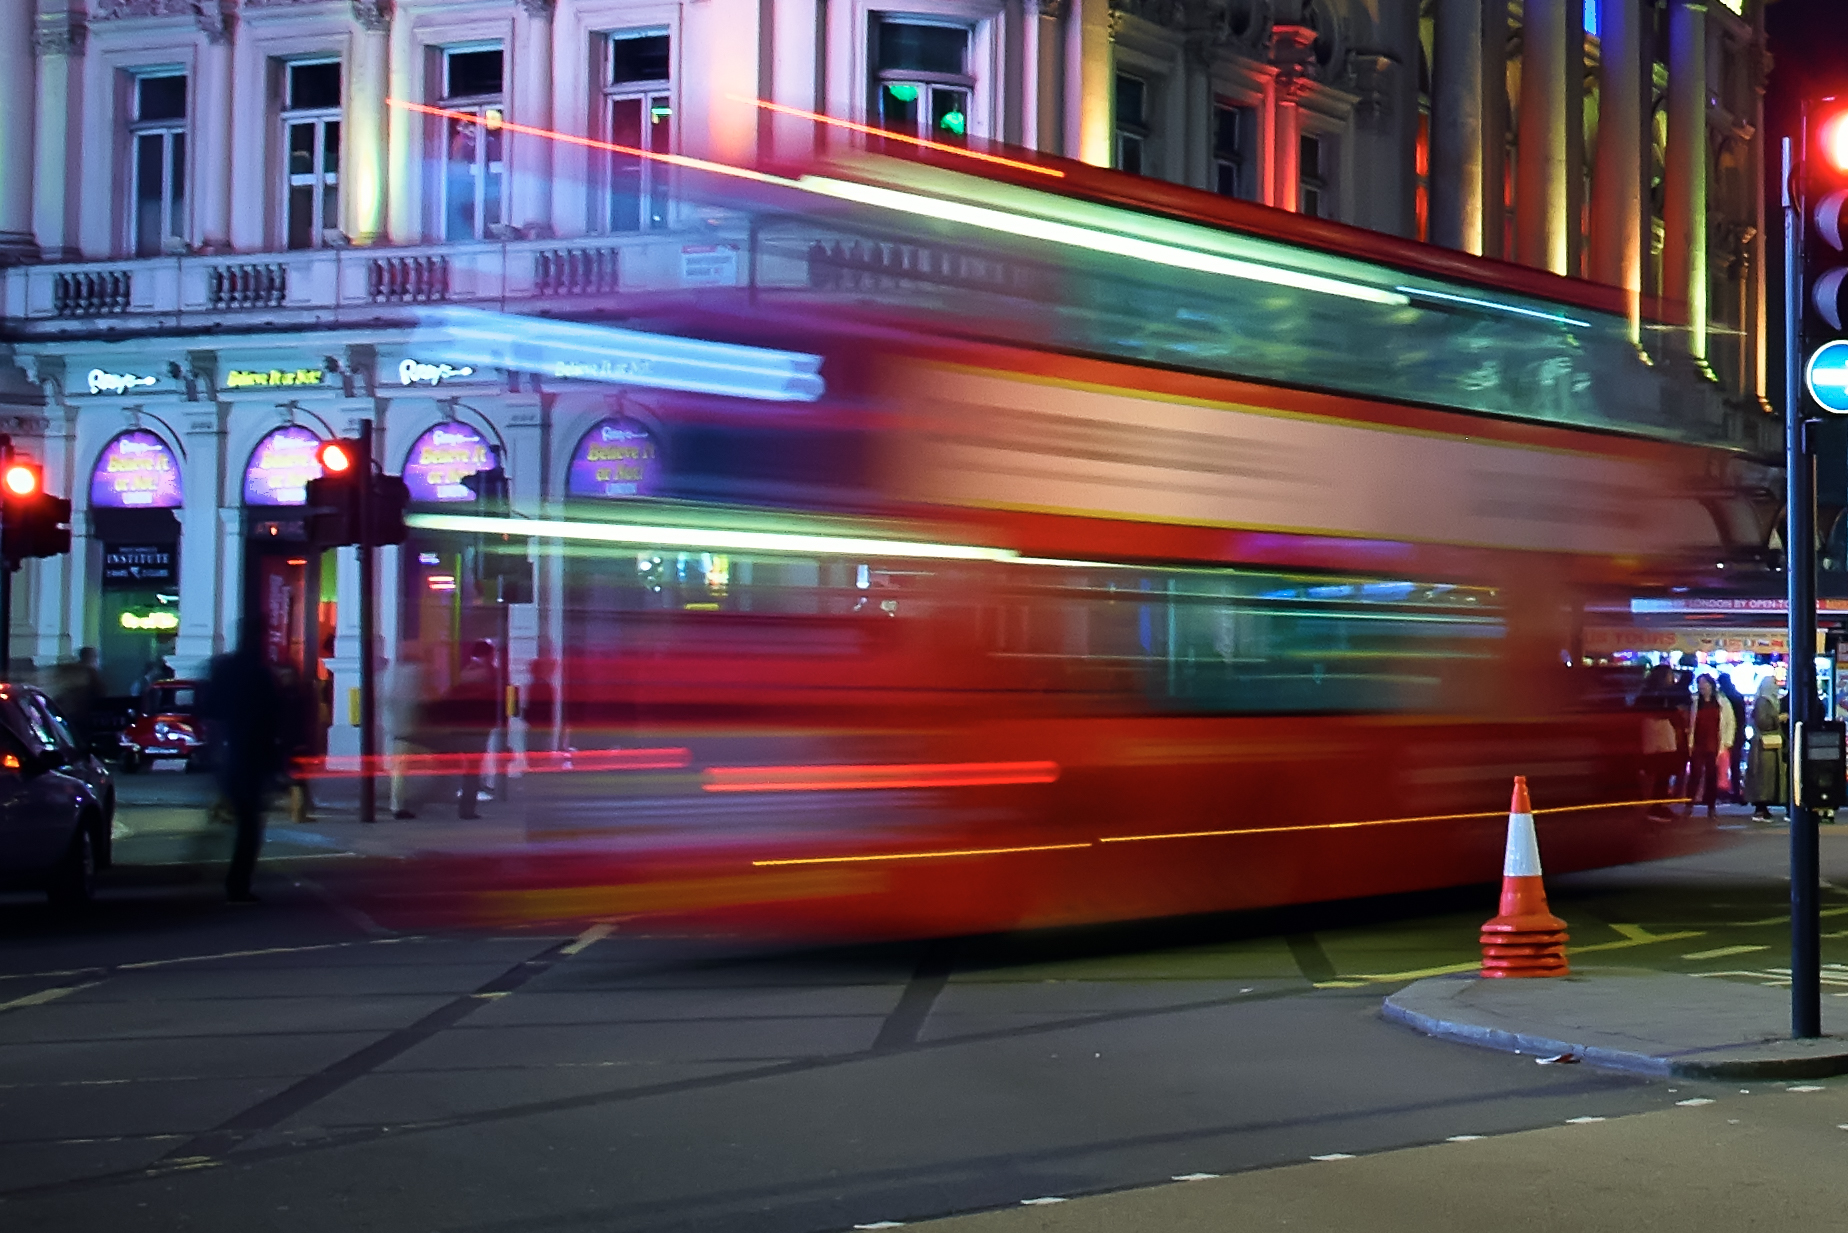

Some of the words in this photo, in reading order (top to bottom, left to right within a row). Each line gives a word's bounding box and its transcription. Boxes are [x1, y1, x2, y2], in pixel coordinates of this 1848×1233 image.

[107, 553, 169, 564] INSTITUTE
[1690, 600, 1731, 609] LONDON
[1734, 600, 1746, 609] BY
[1749, 600, 1789, 609] OPEN-TO
